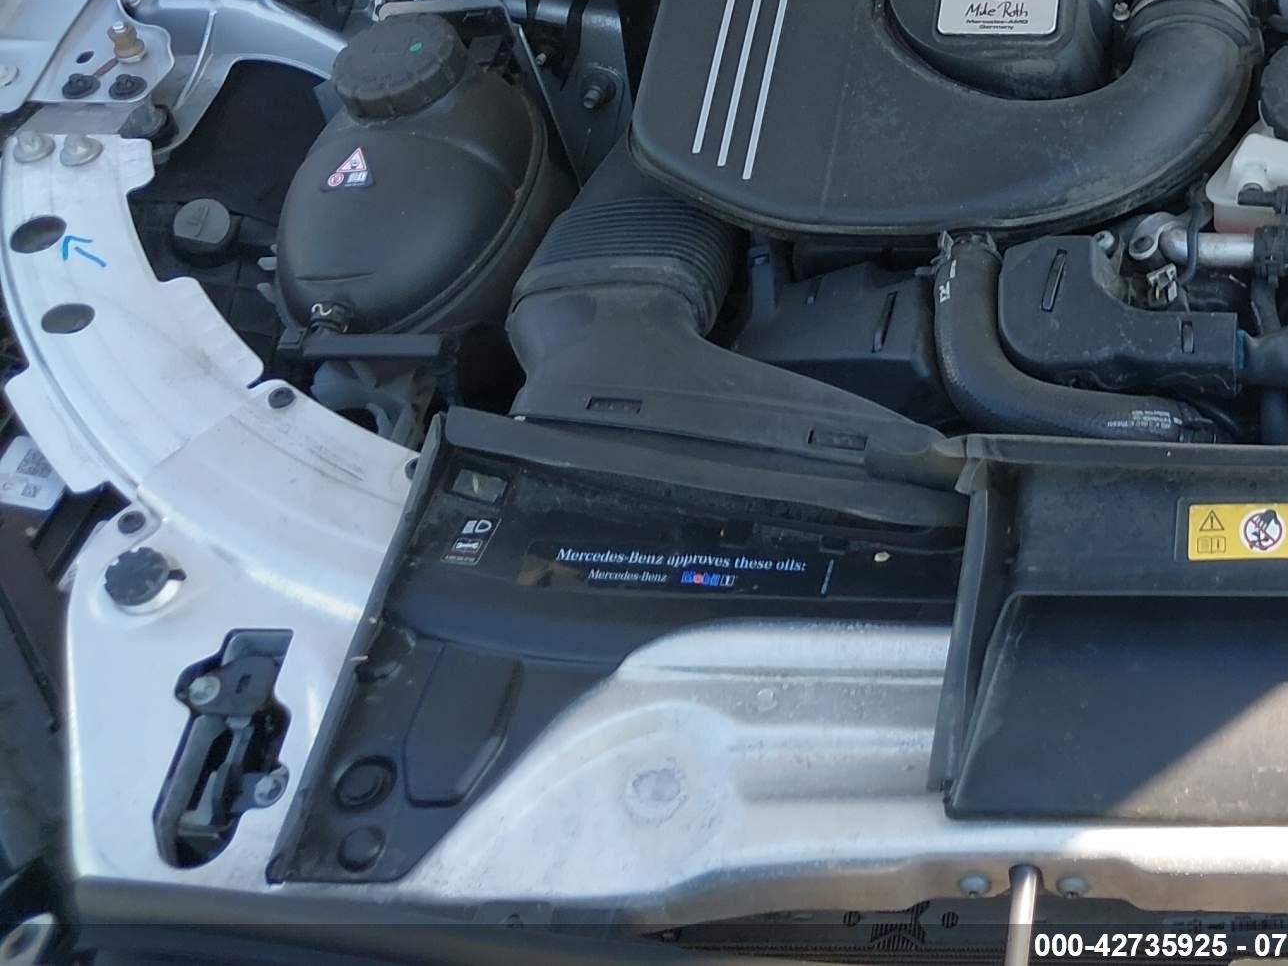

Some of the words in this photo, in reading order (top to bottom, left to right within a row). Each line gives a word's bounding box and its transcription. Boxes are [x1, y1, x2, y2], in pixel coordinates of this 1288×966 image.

[997, 1, 1028, 19] Roth
[556, 548, 664, 565] Mercedes-Benz
[666, 553, 730, 568] approves
[734, 555, 773, 569] these
[775, 558, 807, 571] oils:
[588, 569, 667, 583] Mercedes-Benz
